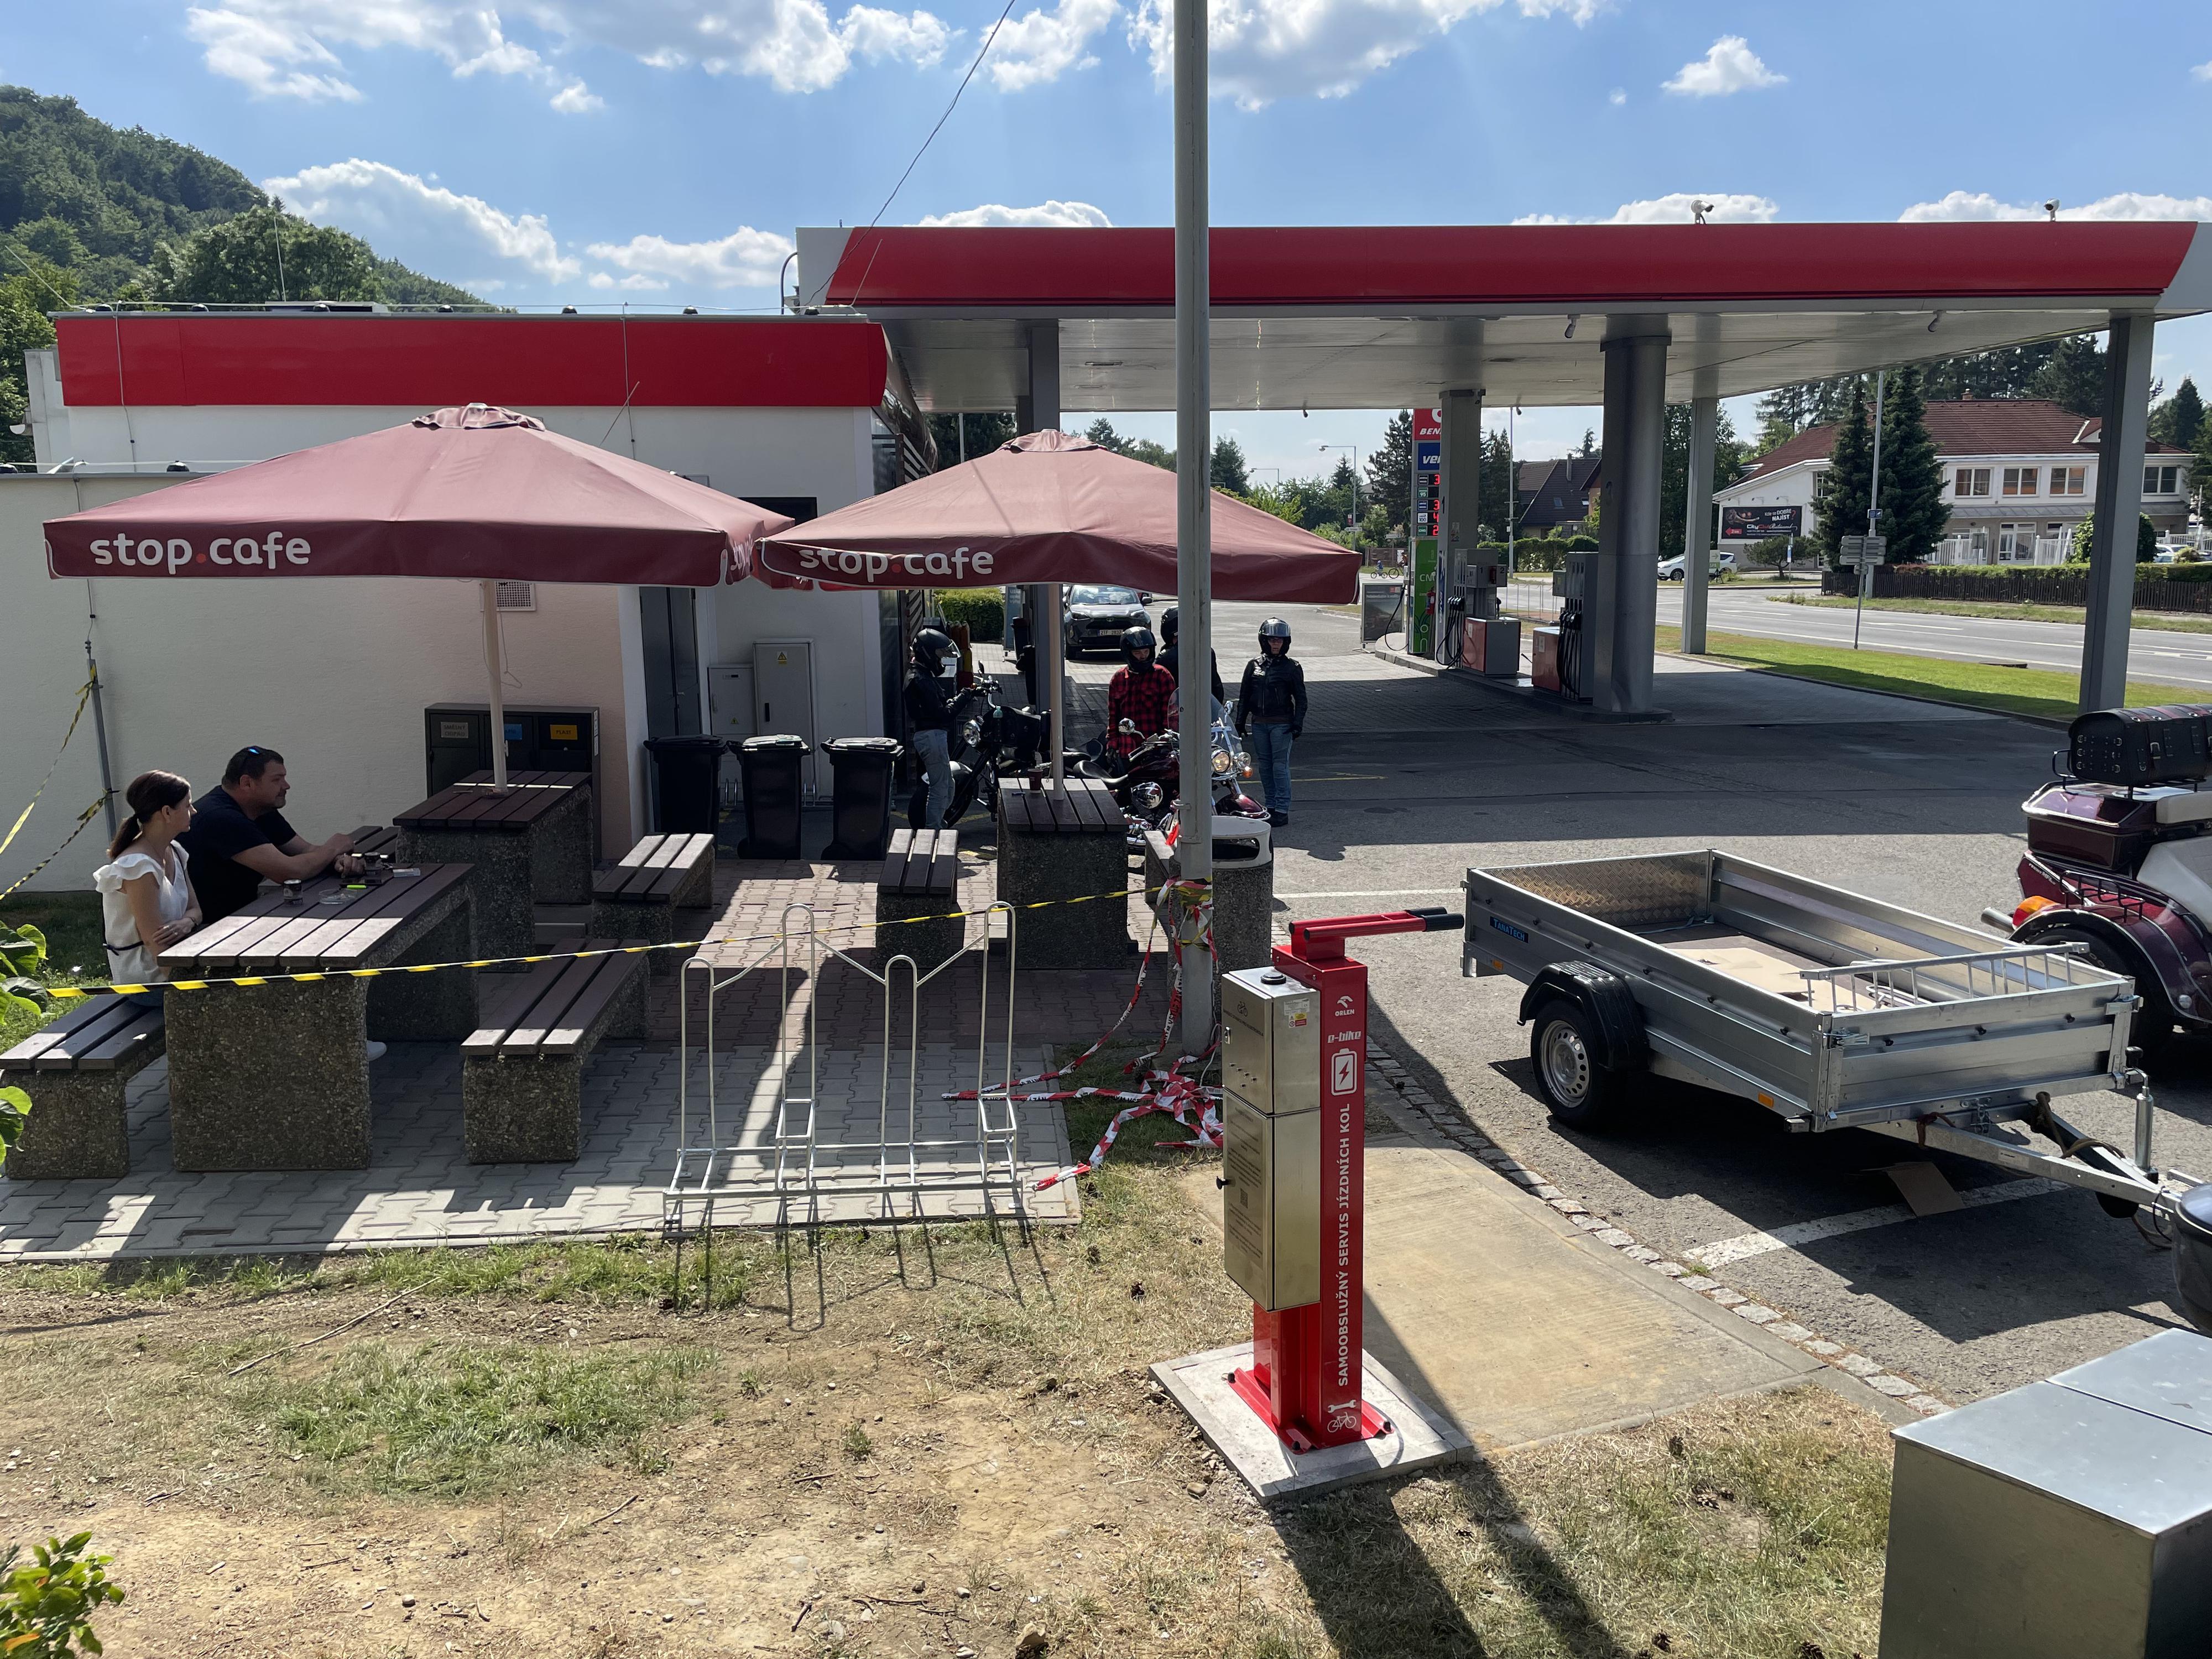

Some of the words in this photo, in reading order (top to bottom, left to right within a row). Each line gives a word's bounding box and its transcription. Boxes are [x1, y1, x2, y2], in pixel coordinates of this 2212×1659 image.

[1442, 496, 1444, 513] 1
[90, 531, 311, 575] stop.cafe
[798, 547, 993, 582] stop.cafe
[1327, 1031, 1361, 1044] e-bike
[1339, 1104, 1350, 1133] KOL
[1336, 1138, 1350, 1208] JÍZDNÍCH
[1339, 1213, 1349, 1266] SERVIS
[1335, 1271, 1348, 1386] SAMOOBSLUŽNÝ
